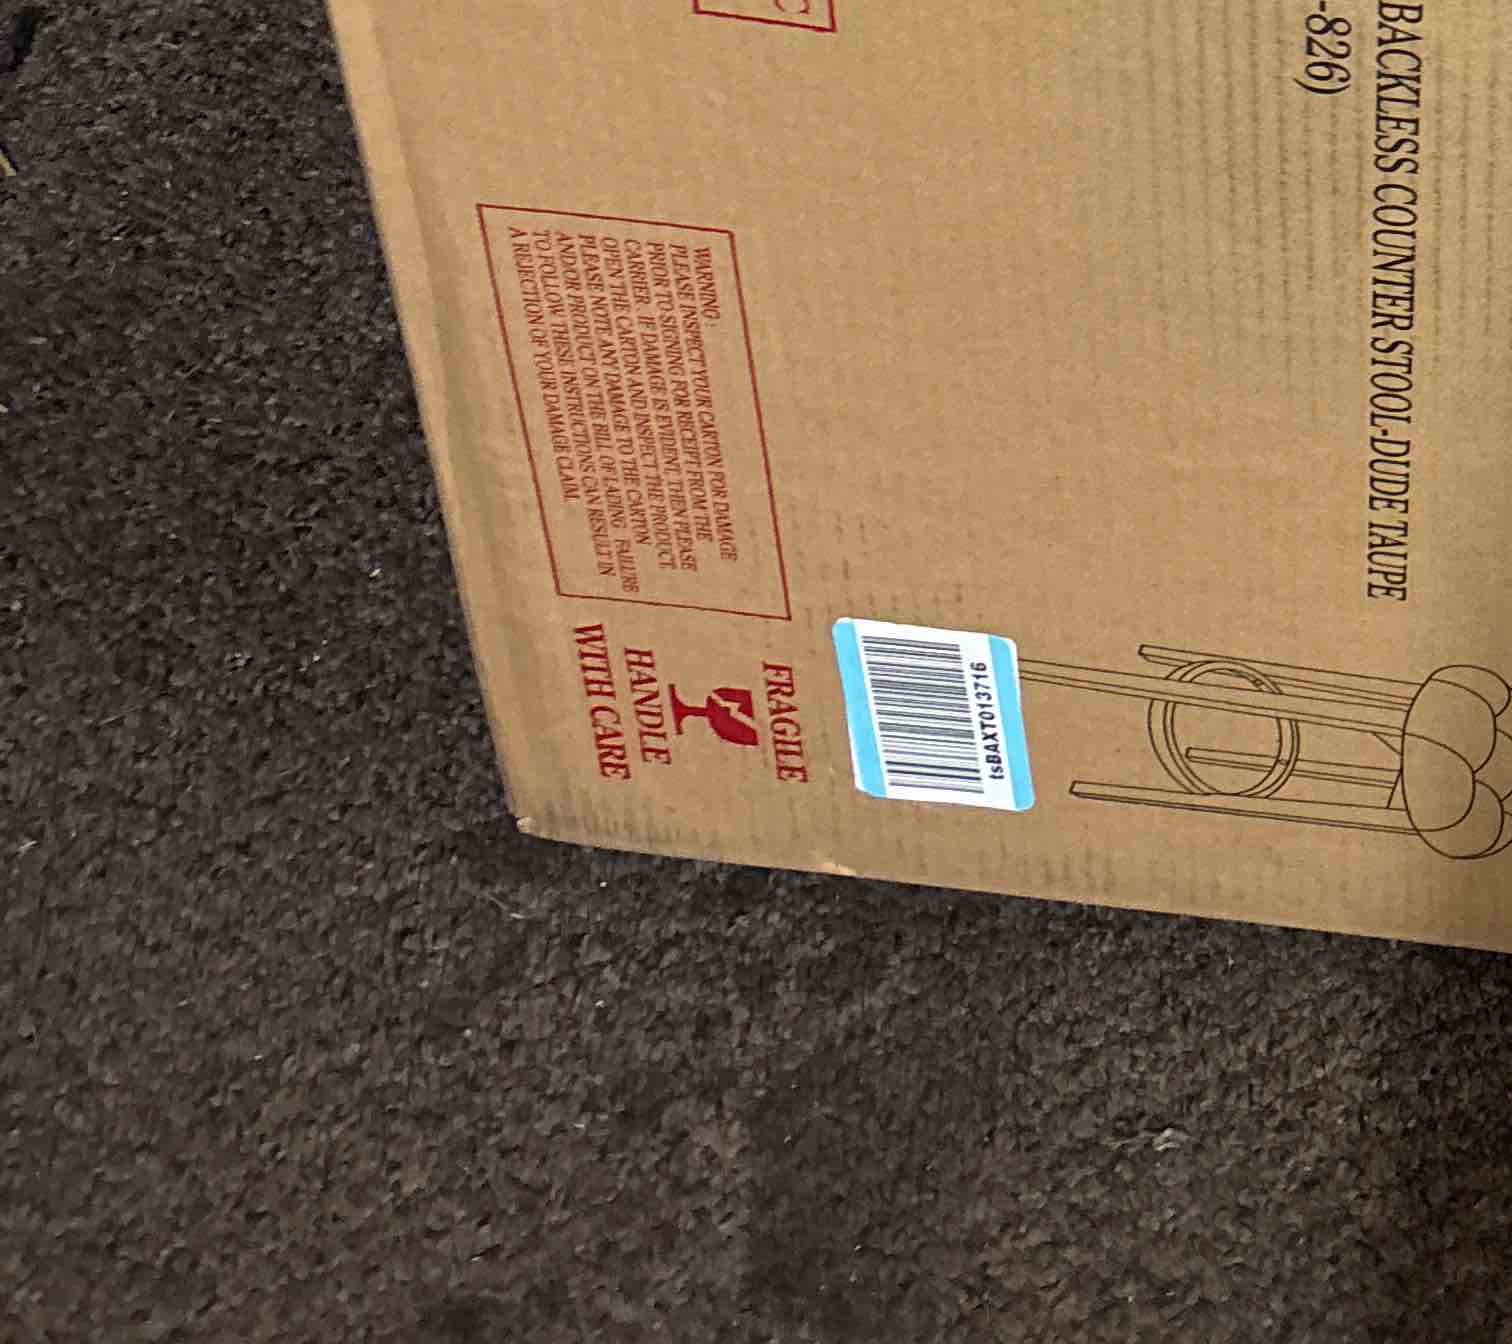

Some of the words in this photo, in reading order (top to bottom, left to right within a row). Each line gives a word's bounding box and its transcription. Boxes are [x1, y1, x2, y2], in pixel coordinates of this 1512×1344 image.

[1372, 0, 1425, 174] BACKLESS
[507, 226, 528, 240] A
[530, 229, 552, 253] TO
[599, 236, 624, 279] OPEN
[1371, 183, 1418, 331] COUNTER
[510, 242, 545, 325] REJECTION
[536, 254, 565, 316] FOLLOW
[577, 233, 604, 291] PLEASE
[646, 241, 671, 287] PRIOR
[668, 243, 695, 300] PLEASE
[588, 295, 613, 337] NOTE
[607, 281, 630, 312] THE
[636, 313, 656, 329] IF
[654, 288, 675, 311] TO
[527, 328, 550, 349] OF
[548, 318, 575, 367] THESE
[565, 293, 596, 366] PRODUCT
[613, 315, 642, 376] CARTON
[658, 312, 686, 376] SIGNING
[678, 303, 706, 366] INSPECT
[532, 350, 558, 391] YOUR
[580, 367, 600, 388] ON
[596, 339, 619, 370] ANY
[639, 331, 667, 395] DAMAGE
[584, 390, 606, 420] THE
[603, 371, 631, 434] DAMAGE
[625, 378, 648, 410] AND
[651, 397, 670, 412] IS
[669, 379, 691, 408] FOR
[689, 367, 713, 408] YOUR
[541, 393, 571, 454] DAMAGE
[559, 370, 595, 472] INSTRUCTIONS
[590, 422, 613, 452] BILL
[615, 436, 635, 455] TO
[631, 412, 659, 470] INSPECT
[675, 409, 701, 467] RECEIPT
[696, 410, 722, 467] CARTON
[1368, 337, 1415, 511] STOOL-DUDE
[596, 454, 617, 476] OF
[619, 458, 640, 487] THE
[642, 474, 664, 501] THE
[685, 469, 708, 510] FROM
[706, 470, 727, 498] FOR
[579, 475, 602, 505] CAN
[665, 479, 688, 518] THEN
[586, 508, 612, 559] RESULT
[625, 489, 651, 545] CARTON
[692, 512, 713, 542] THE
[711, 501, 738, 562] DAMAGE
[597, 561, 615, 577] IN
[613, 538, 639, 593] FAILURE
[673, 520, 698, 571] PLEASE
[1366, 519, 1408, 601] TAUPE
[572, 623, 617, 700] WITH
[624, 647, 671, 765] HANDLE
[762, 661, 808, 783] FRAGILE
[590, 705, 631, 779] CARE
